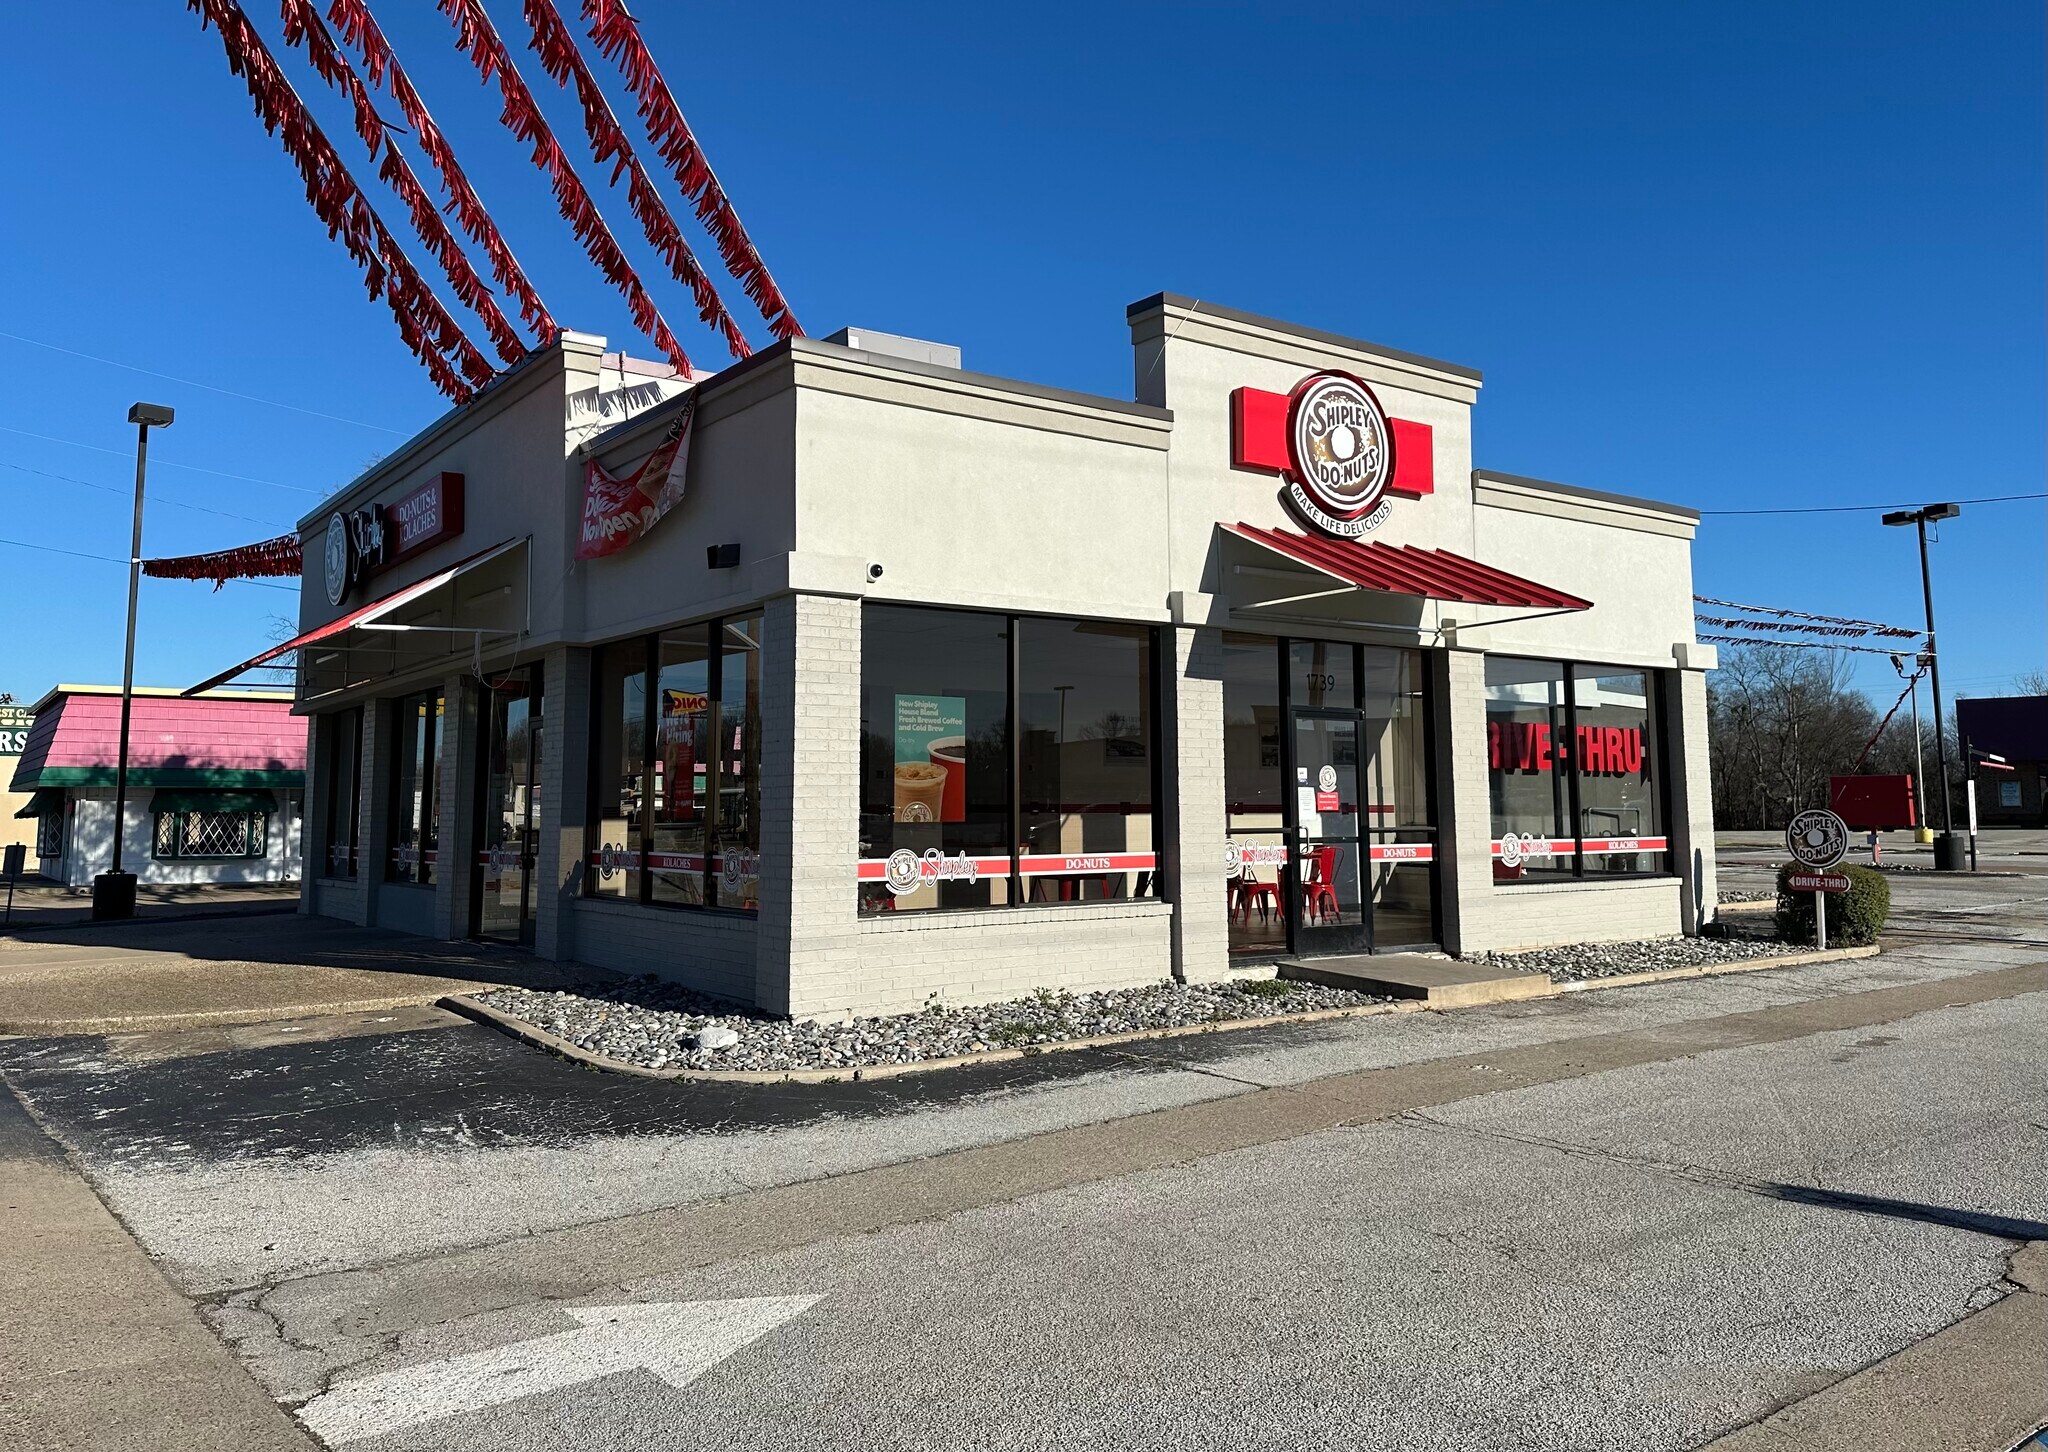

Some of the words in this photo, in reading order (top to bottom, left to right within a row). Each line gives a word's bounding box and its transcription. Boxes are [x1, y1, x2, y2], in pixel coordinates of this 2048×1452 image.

[1312, 401, 1371, 436] SHIPLEY
[1319, 447, 1378, 485] DO-NUTS
[1292, 486, 1318, 520] MAKE
[1320, 516, 1341, 533] LIFE
[1343, 504, 1390, 535] DELICIOUS
[399, 509, 436, 544] KOLACHES
[1306, 673, 1335, 692] 1739
[914, 701, 938, 709] Shipley
[920, 708, 938, 716] Blend
[899, 716, 916, 724] Fresh
[917, 716, 941, 724] Brewed
[942, 717, 963, 725] Coffee
[1793, 818, 1837, 837] SHIPLEY
[1608, 841, 1638, 850] KOLACHES
[1799, 838, 1841, 860] DO-NUTS
[1383, 848, 1417, 858] DO-NUTS
[663, 857, 691, 869] KOLACHES
[891, 856, 915, 869] SHIPLEY
[924, 847, 979, 888] Shipley
[1065, 857, 1111, 870] DO-NUTS
[1795, 876, 1847, 888] DRIVE-THRU
